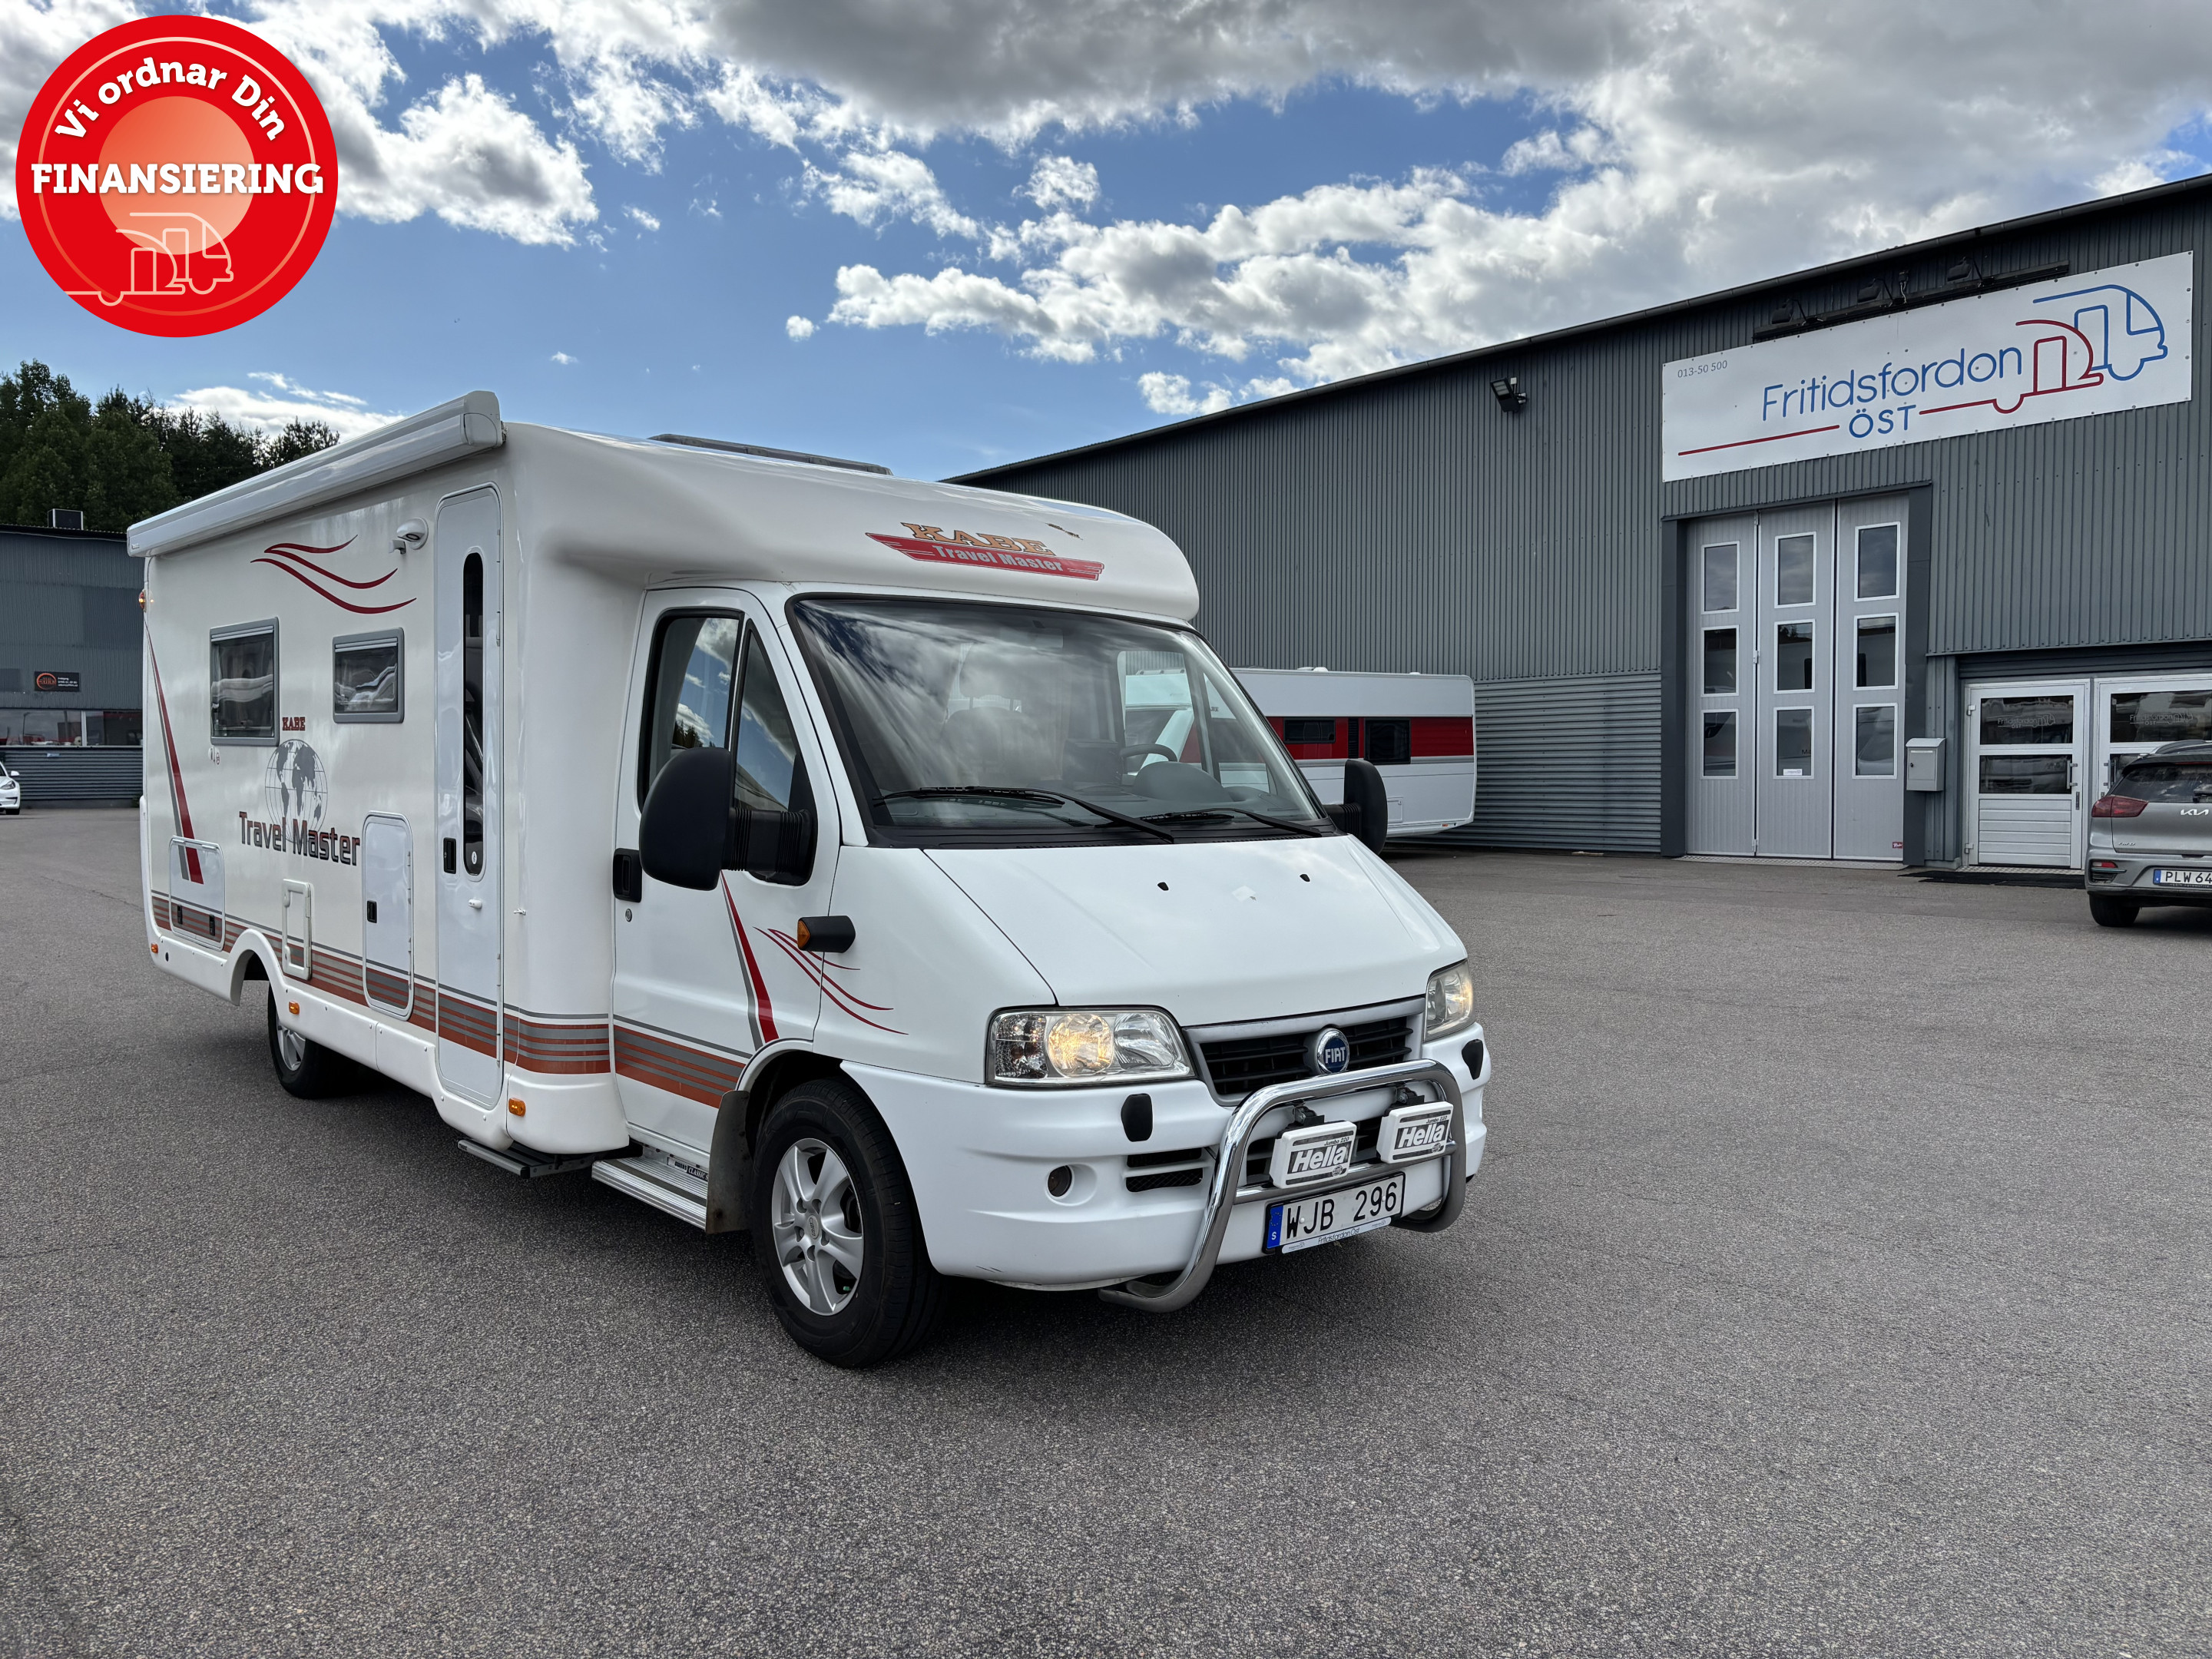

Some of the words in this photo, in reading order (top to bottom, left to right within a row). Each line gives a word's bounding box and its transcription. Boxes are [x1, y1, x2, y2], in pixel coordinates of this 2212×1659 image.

[1677, 365, 1709, 378] 013-50
[1710, 360, 1727, 371] 500
[1763, 348, 2022, 422] Fritidsfordon
[1848, 404, 1916, 439] ÖST
[900, 522, 1056, 555] KABE
[932, 545, 995, 564] Travel
[998, 553, 1064, 571] Master
[282, 717, 306, 731] KABE
[239, 811, 286, 852] Travel
[293, 819, 360, 866] Master
[2165, 871, 2192, 883] PLW
[1325, 1047, 1346, 1064] FIAT
[1398, 1124, 1445, 1148] Hella
[1292, 1145, 1347, 1172] Hella
[1286, 1198, 1335, 1239] WJB
[1353, 1182, 1396, 1221] 296
[1271, 1231, 1277, 1240] S
